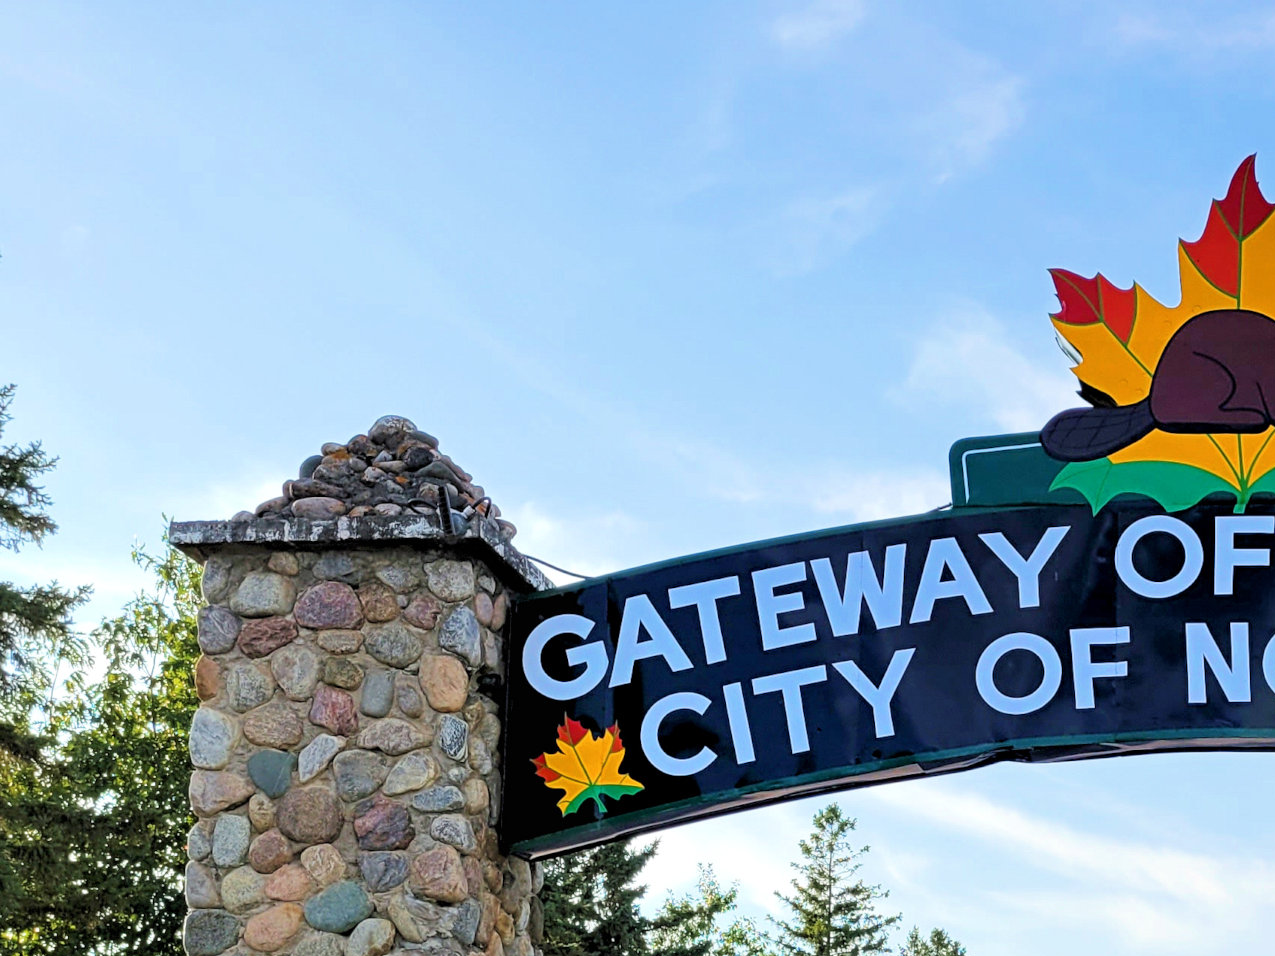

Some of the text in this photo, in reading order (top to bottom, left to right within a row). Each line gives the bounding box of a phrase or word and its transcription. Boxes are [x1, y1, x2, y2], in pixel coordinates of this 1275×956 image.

[522, 525, 1071, 701] GATEWAY
[1114, 514, 1275, 599] OF
[639, 647, 915, 777] CITY
[975, 625, 1131, 715] OF
